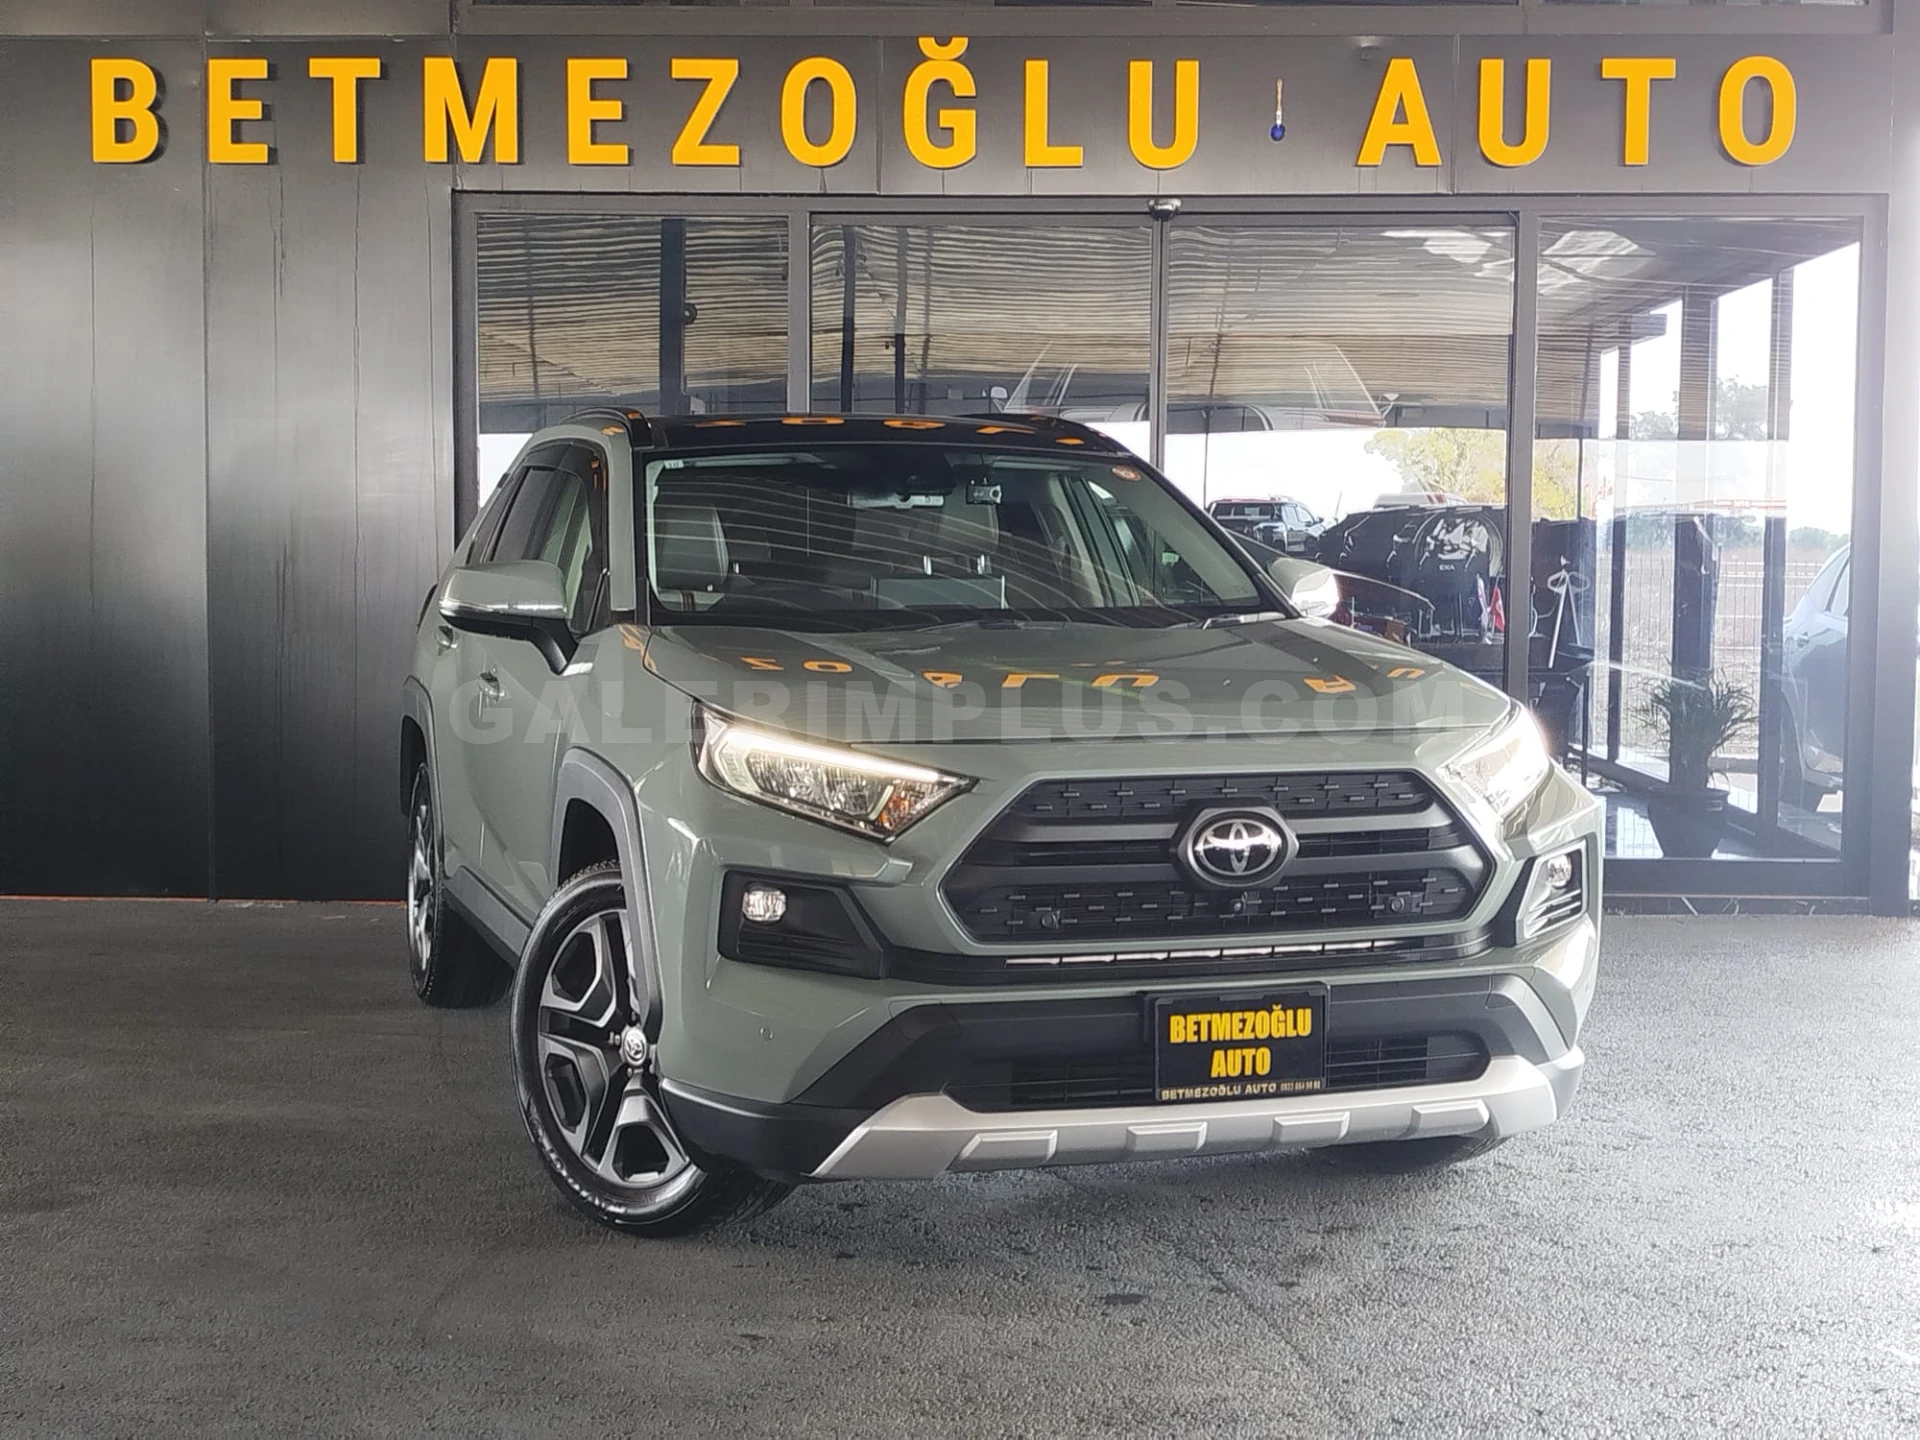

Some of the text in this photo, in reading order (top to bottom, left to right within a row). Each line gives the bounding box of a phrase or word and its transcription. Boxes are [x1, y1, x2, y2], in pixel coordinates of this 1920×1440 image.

[91, 37, 1794, 168] BETMEZOĞLU AUTO
[1170, 1004, 1312, 1043] BETMEZOĞLU
[1210, 1047, 1271, 1077] AUTO
[1245, 1082, 1277, 1094] AUTO
